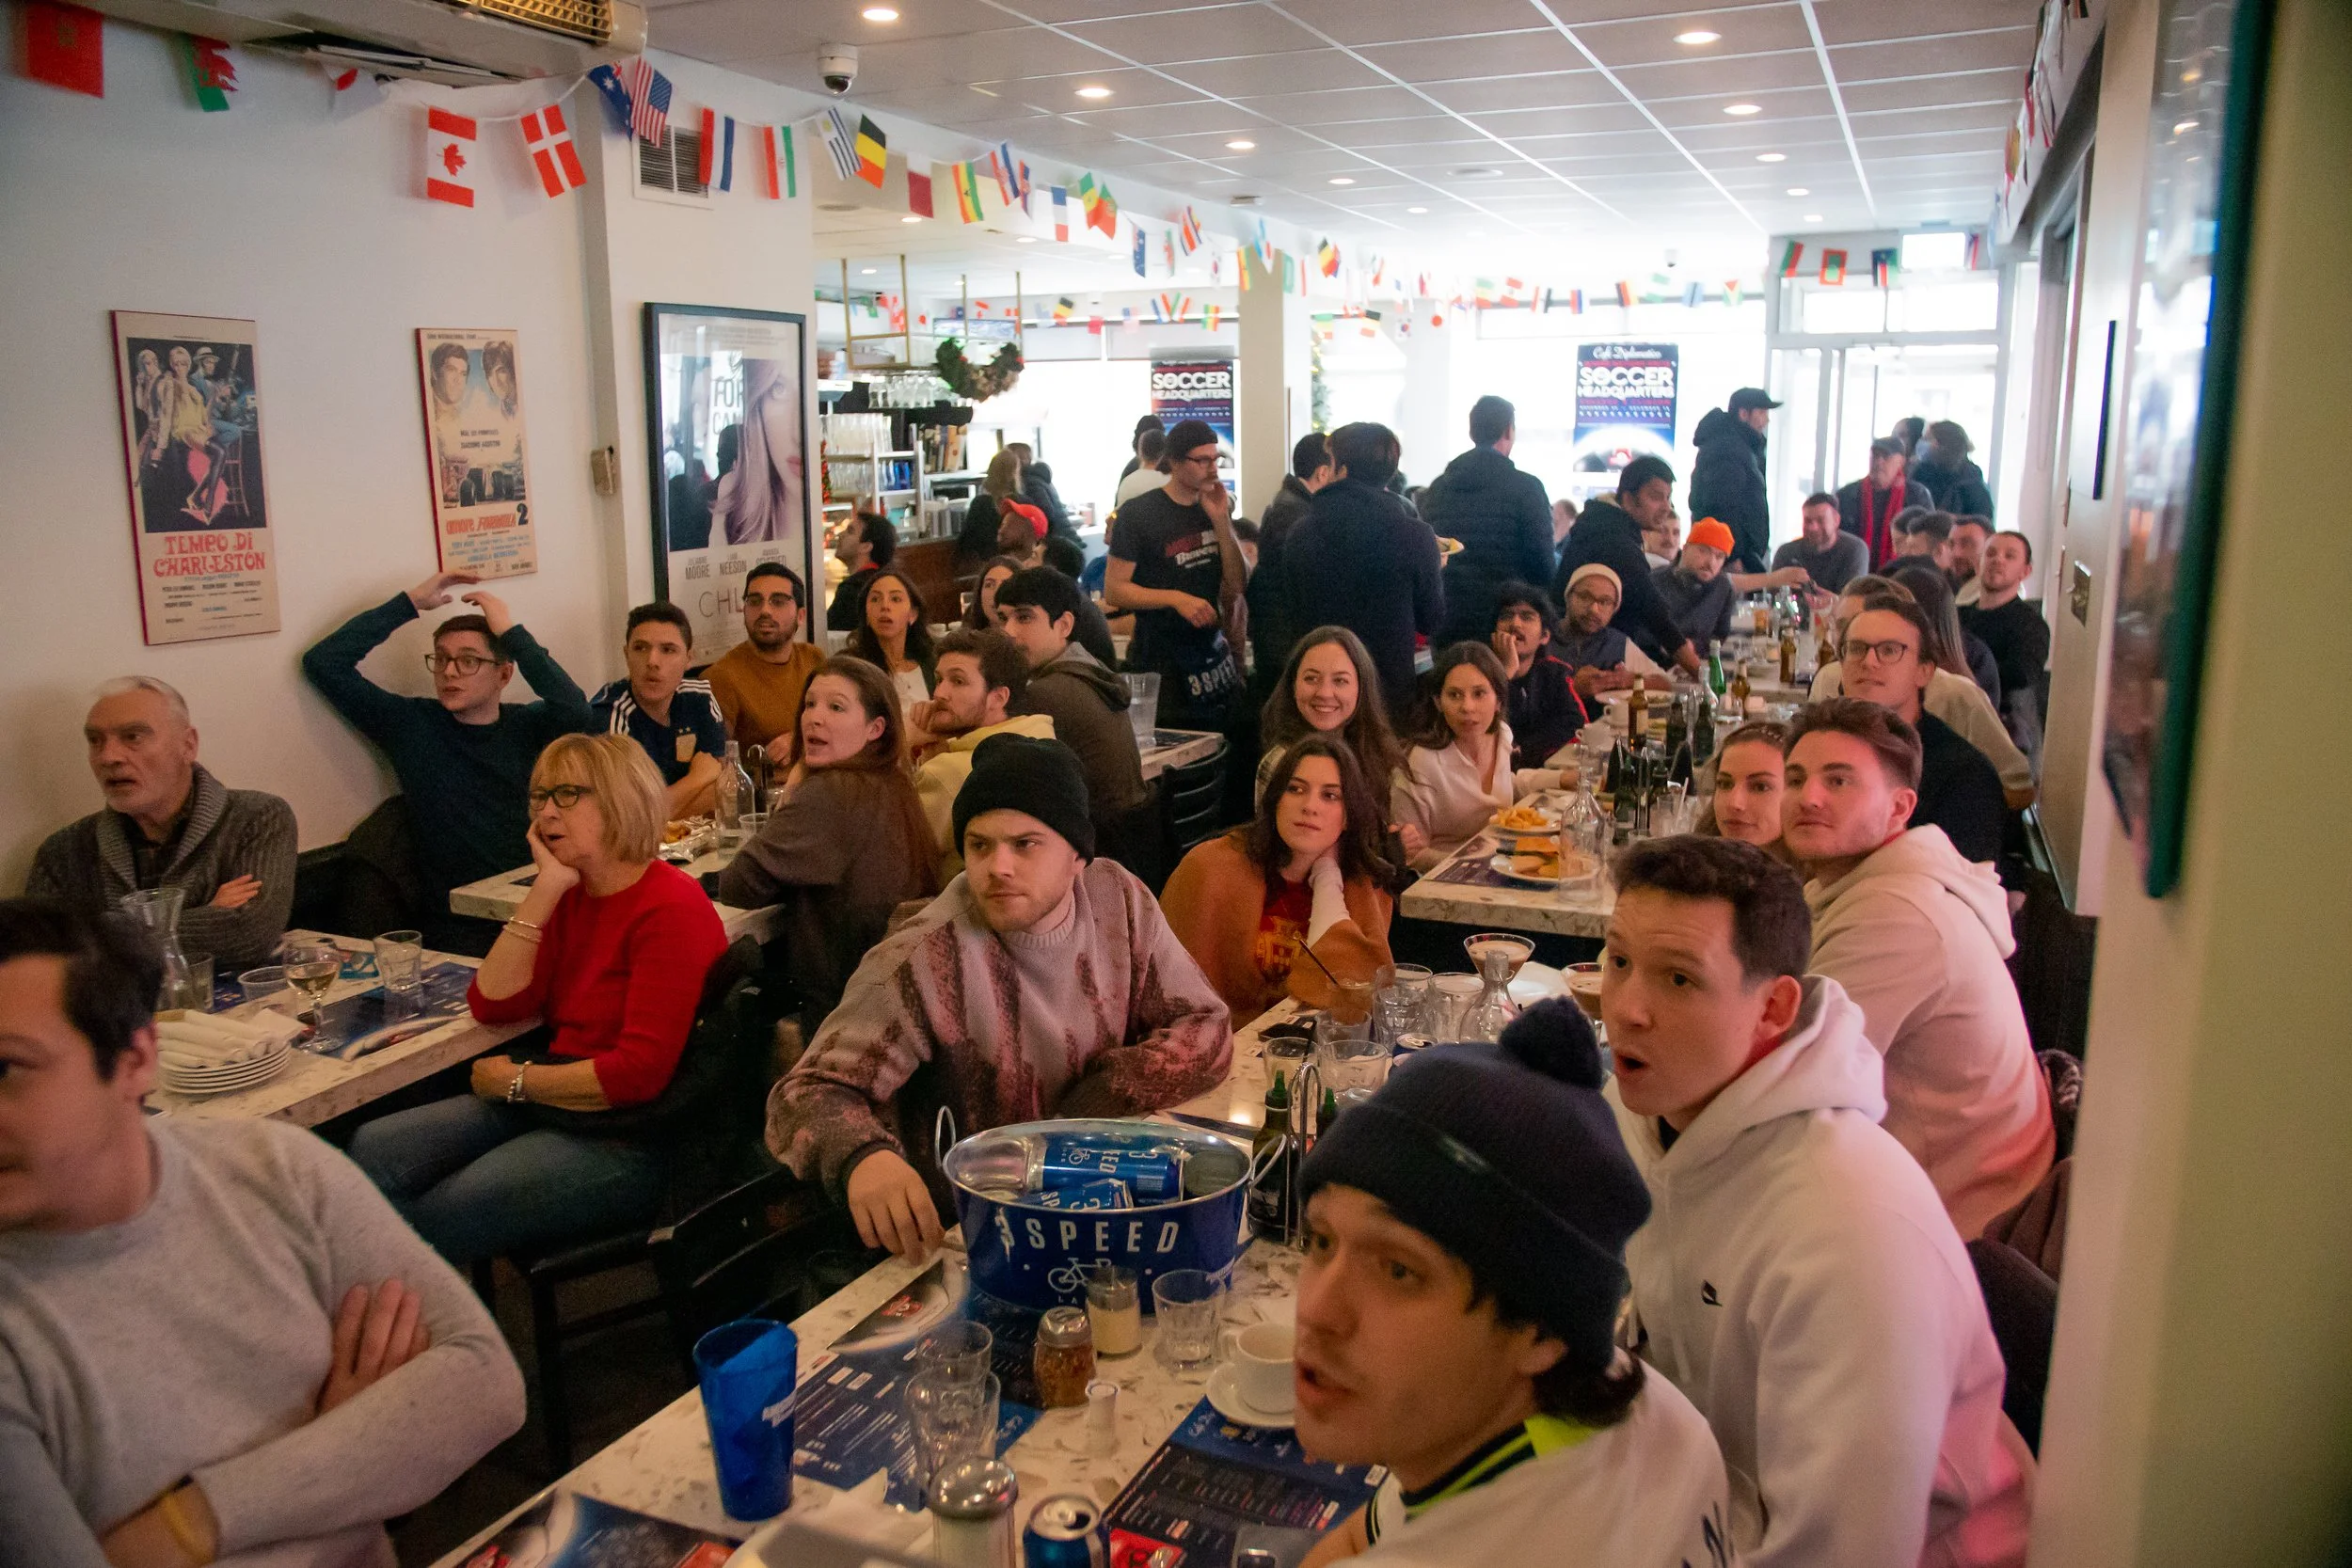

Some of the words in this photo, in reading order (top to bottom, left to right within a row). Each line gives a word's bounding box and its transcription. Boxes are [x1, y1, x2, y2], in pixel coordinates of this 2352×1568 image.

[1152, 372, 1231, 389] SOCCER
[1580, 367, 1674, 387] SOCCER
[1152, 388, 1232, 403] HEADQUARTERS
[1578, 385, 1675, 402] HEADQUARTERS
[516, 502, 529, 526] 2
[165, 533, 229, 555] TEMPO
[153, 552, 266, 578] CHARLESTON
[685, 564, 710, 580] MOORE
[719, 561, 747, 576] NEESON
[1188, 674, 1201, 695] 3
[1025, 1218, 1180, 1254] SPEED
